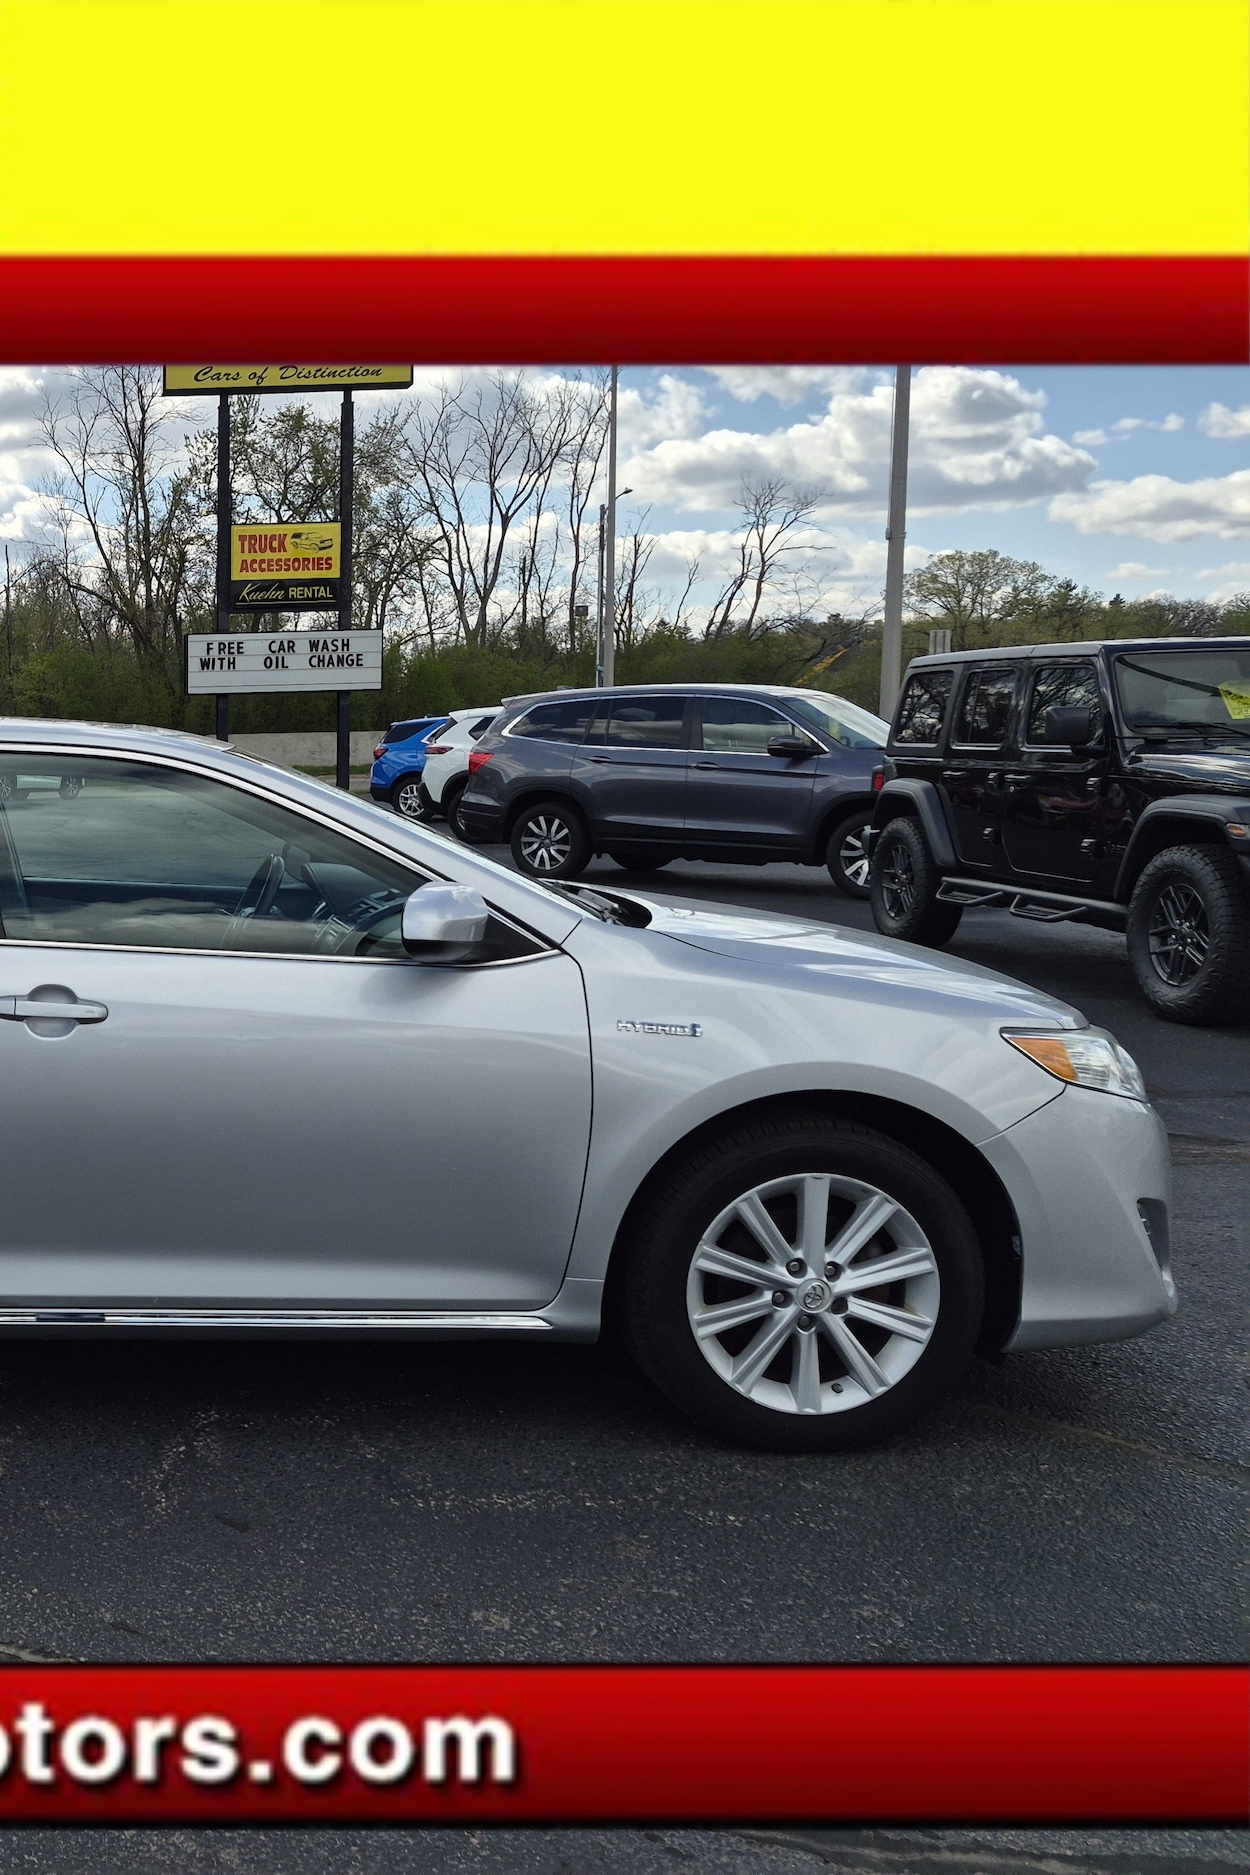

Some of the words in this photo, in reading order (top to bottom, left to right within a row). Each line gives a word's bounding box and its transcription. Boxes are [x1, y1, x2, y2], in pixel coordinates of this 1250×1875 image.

[193, 366, 242, 382] Cars
[248, 366, 269, 385] of
[279, 365, 382, 381] Distinction
[238, 533, 288, 554] TRUCK
[239, 556, 333, 573] ACCESSORIES
[238, 582, 286, 602] Kuehn
[288, 585, 334, 599] RENTAL
[206, 641, 245, 655] FREE
[268, 640, 296, 654] CAR
[309, 638, 351, 652] WASH
[199, 656, 237, 671] WITH
[263, 656, 289, 669] OIL
[308, 653, 364, 668] CHANGE
[617, 1020, 690, 1036] HYBRID
